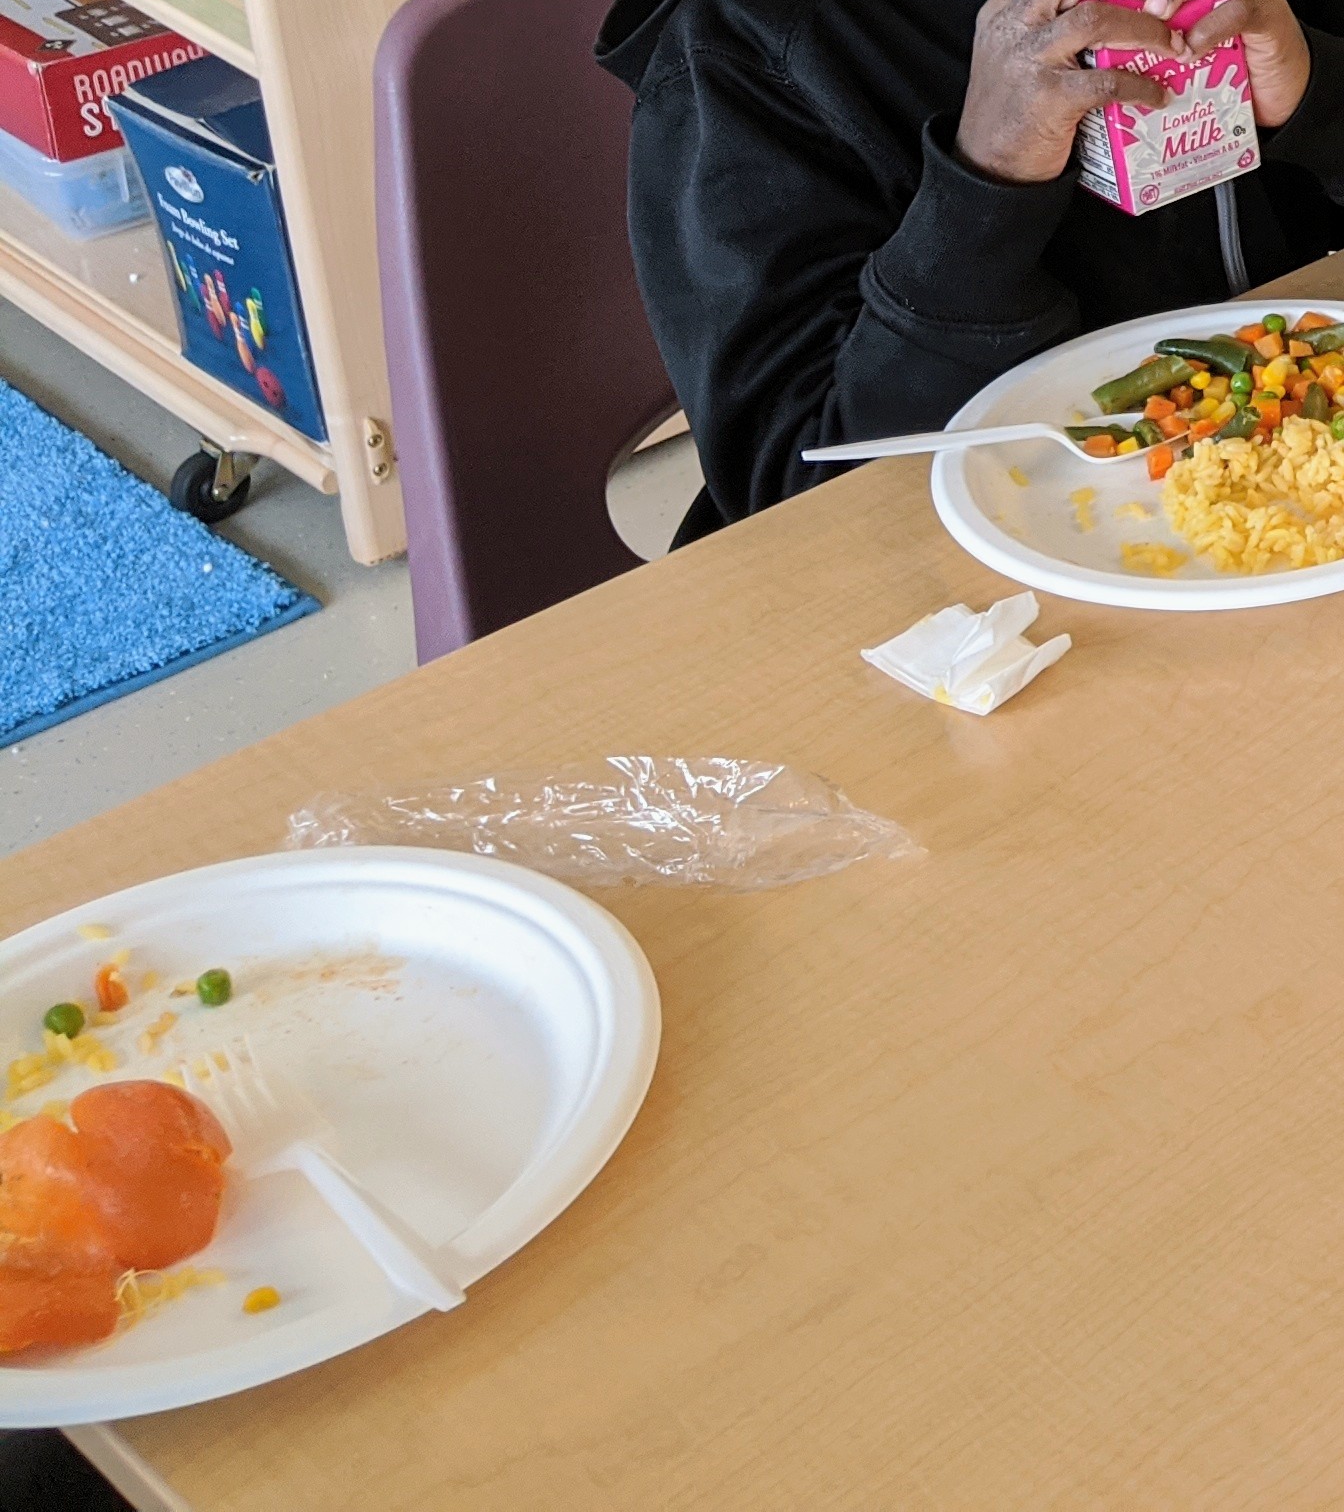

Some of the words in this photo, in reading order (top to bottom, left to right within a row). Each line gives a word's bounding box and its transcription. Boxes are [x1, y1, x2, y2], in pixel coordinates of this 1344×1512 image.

[1162, 100, 1215, 132] Lowfat
[1161, 117, 1225, 164] Milk
[1222, 145, 1228, 155] A
[1234, 140, 1241, 150] D
[220, 228, 240, 250] Set
